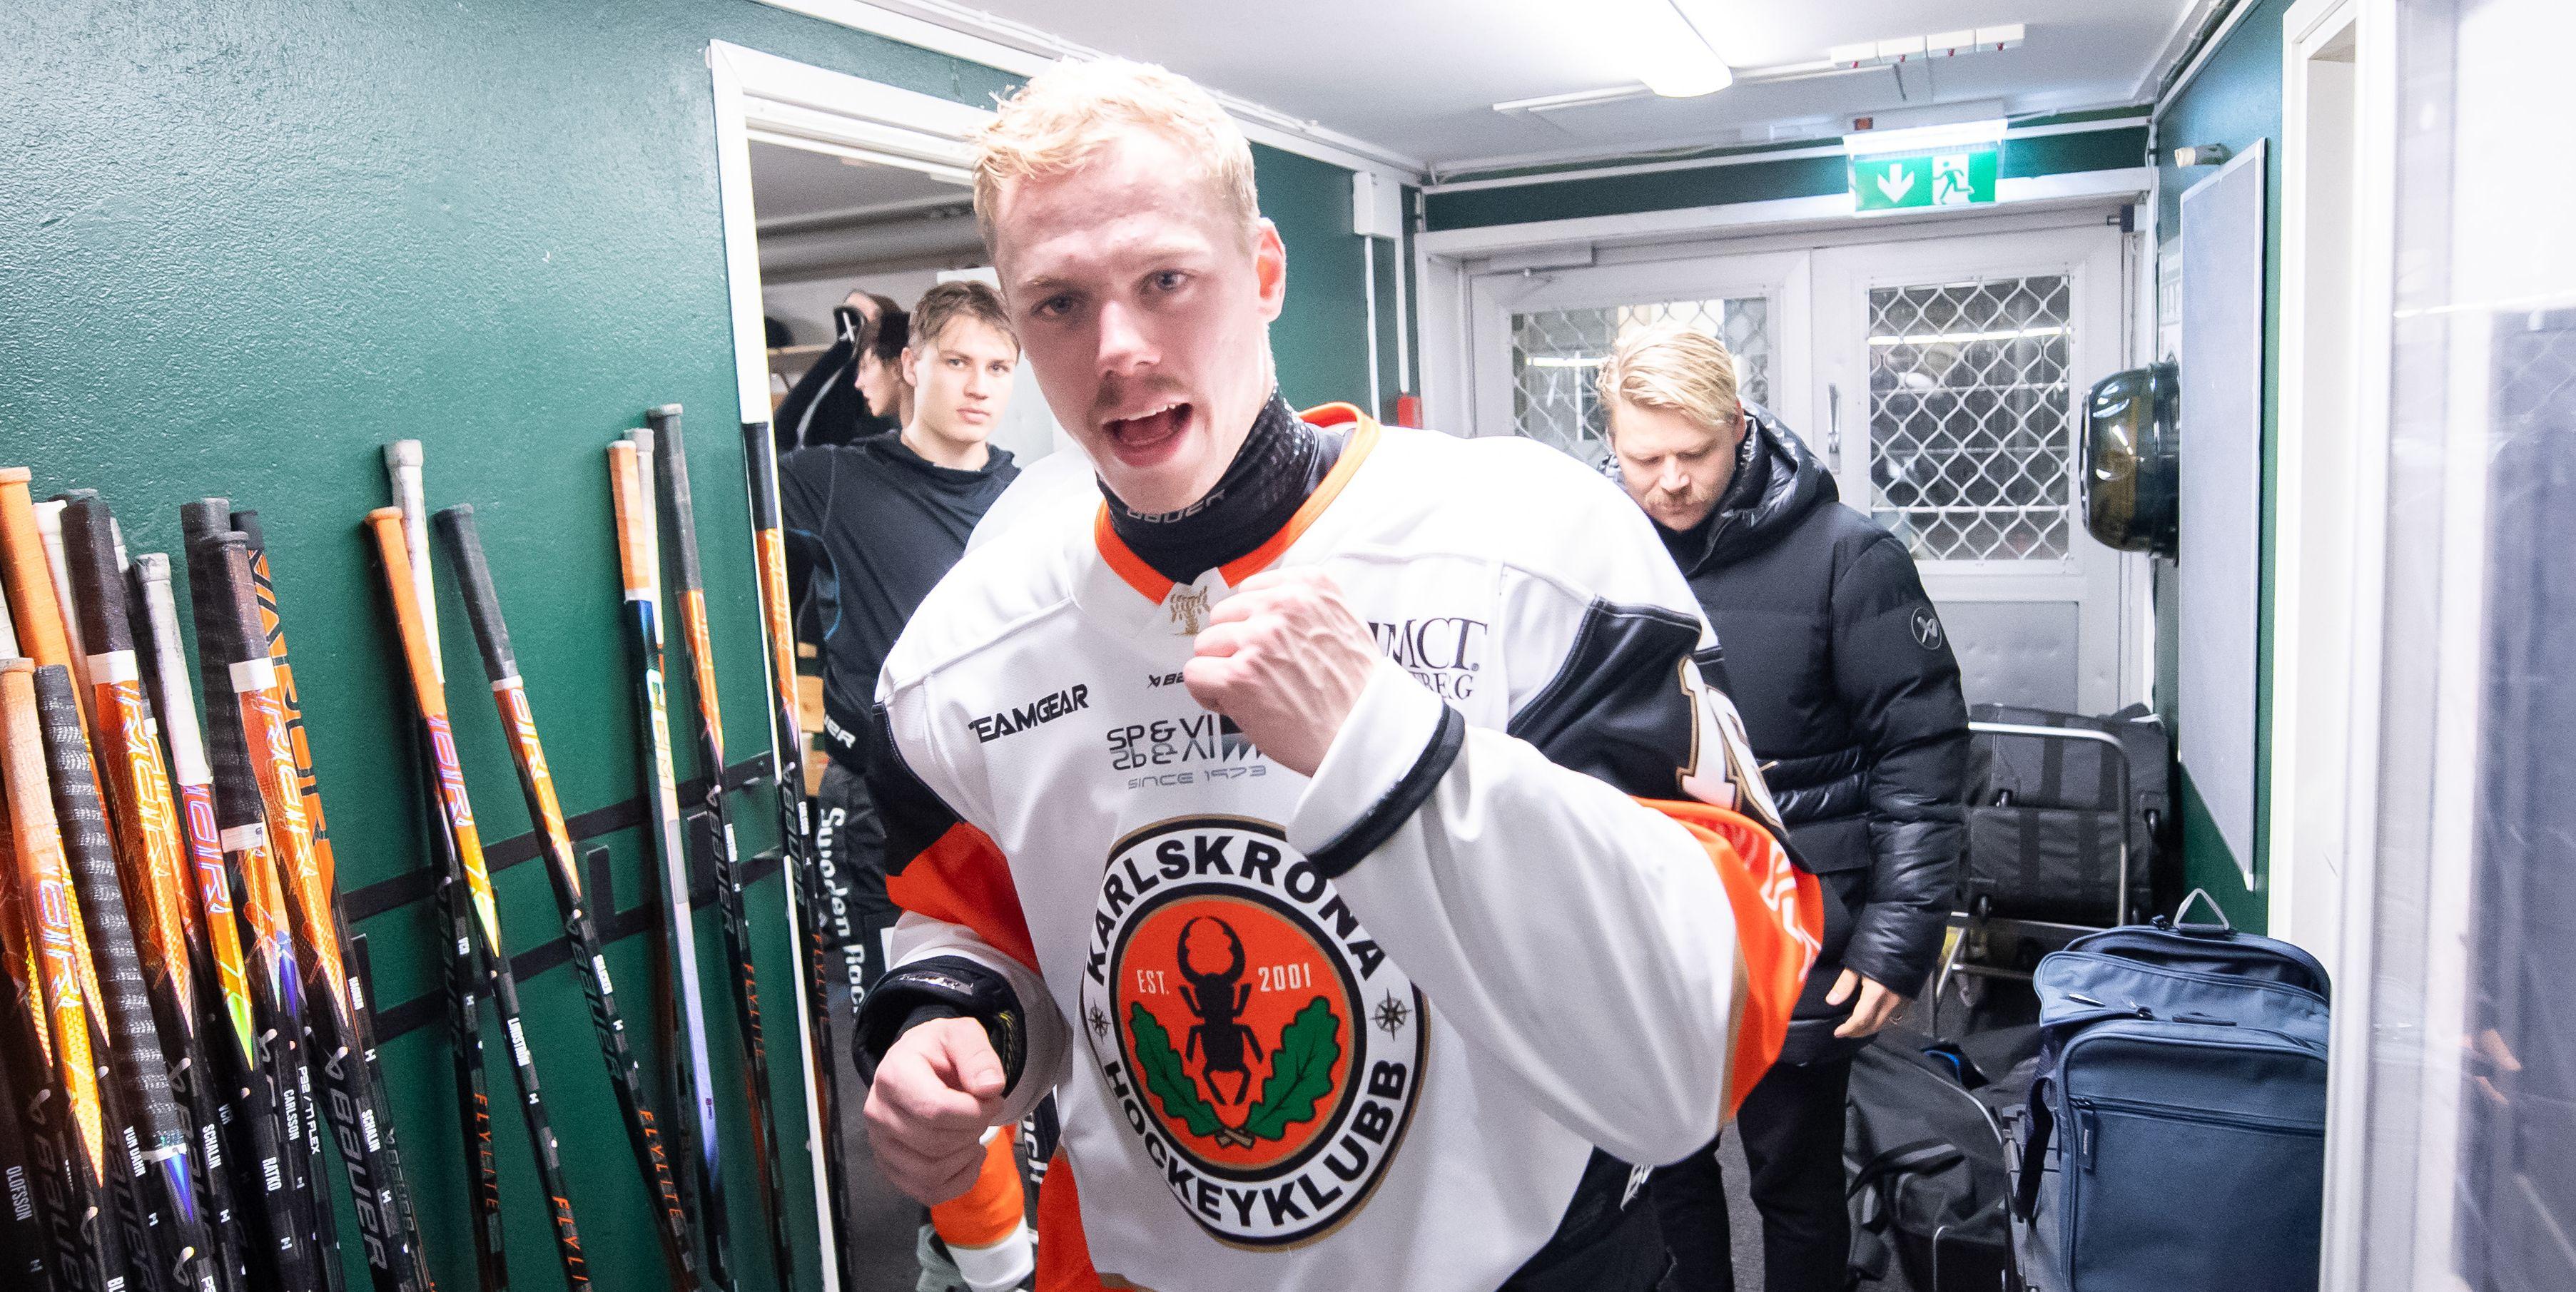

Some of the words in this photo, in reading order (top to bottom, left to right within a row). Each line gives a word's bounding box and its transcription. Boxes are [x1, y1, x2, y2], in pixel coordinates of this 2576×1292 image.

[1128, 773, 1194, 790] SINCE
[1204, 765, 1267, 782] 1973
[1085, 834, 1386, 987] KARLSKRONA
[843, 944, 866, 1014] Roc
[1136, 969, 1170, 996] EST.
[1257, 962, 1312, 993] 2001
[283, 1089, 300, 1141] CARLSSON
[298, 1066, 310, 1094] P92
[307, 1119, 320, 1155] FLEX
[361, 1109, 381, 1153] SCHALIN
[202, 1123, 222, 1169] SCHALIN
[262, 1156, 282, 1191] RATKO
[474, 1092, 499, 1209] FLYLITE
[639, 1109, 684, 1218] FLYLITE
[1104, 1060, 1408, 1228] HOCKEYKLUBB
[6, 1165, 33, 1221] OLOFSSON
[552, 1196, 589, 1281] FLYLI
